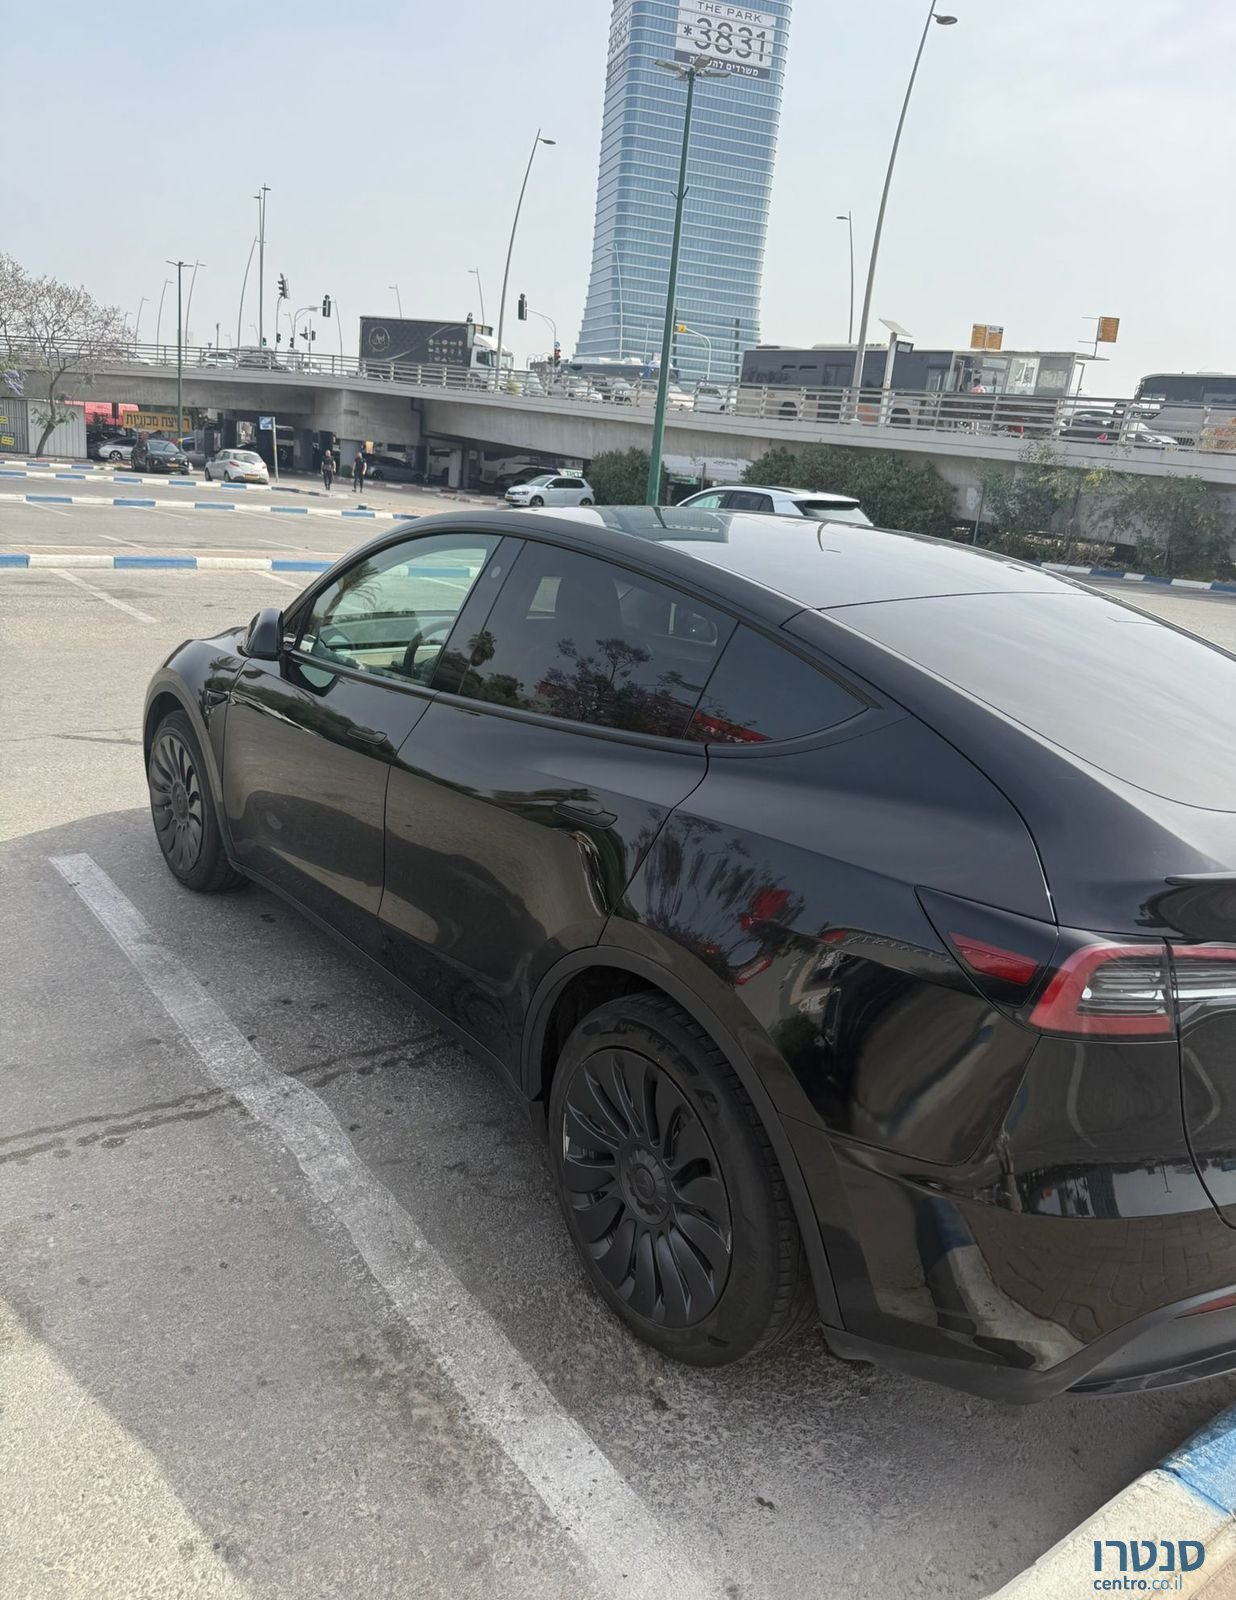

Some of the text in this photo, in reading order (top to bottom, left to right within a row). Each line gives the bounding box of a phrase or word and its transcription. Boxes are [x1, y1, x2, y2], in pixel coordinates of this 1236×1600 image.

[697, 2, 762, 23] THE PARK
[689, 55, 759, 76] משרדים להה
[126, 414, 190, 429] ריצת מכוניות
